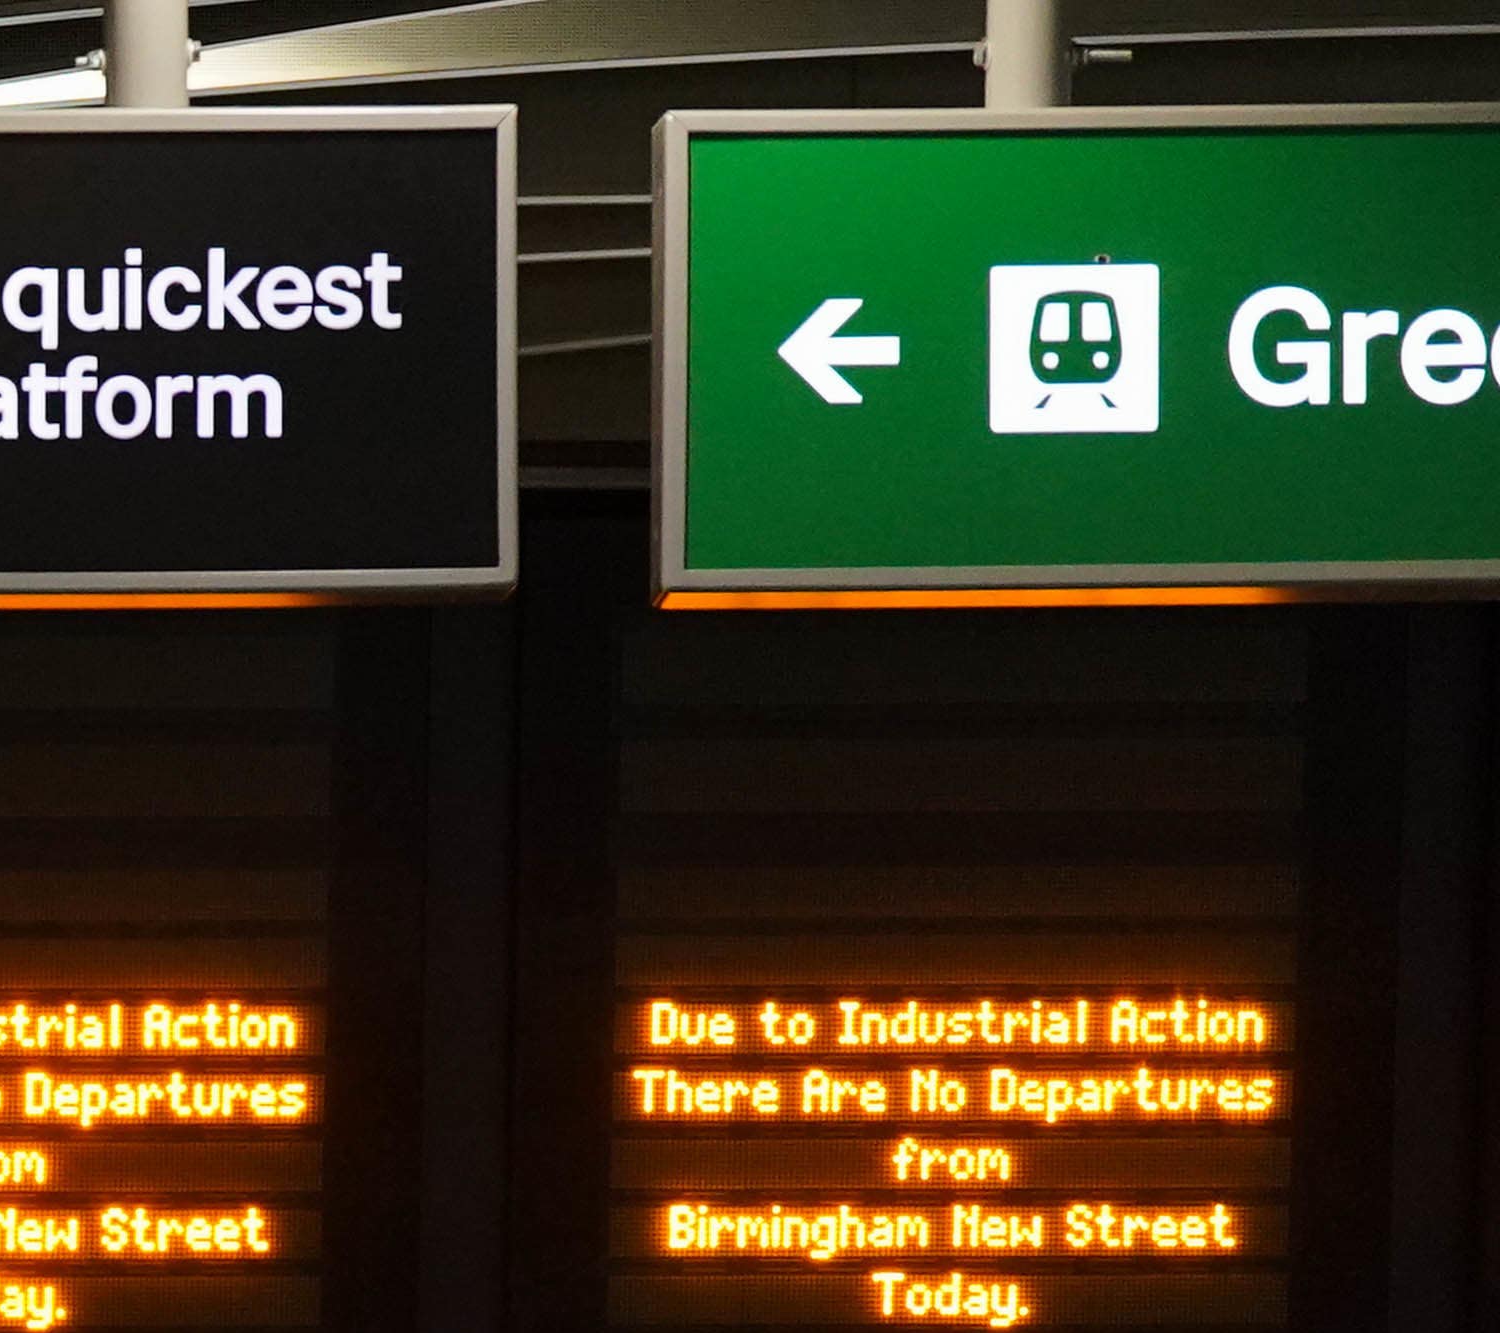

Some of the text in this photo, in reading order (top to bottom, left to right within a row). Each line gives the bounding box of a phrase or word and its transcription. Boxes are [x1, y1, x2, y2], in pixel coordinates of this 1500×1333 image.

[3, 248, 402, 349] quickest
[1228, 285, 1500, 407] Gre
[139, 1003, 298, 1050] Action
[649, 998, 1267, 1047] Due to Industrial Action
[21, 1069, 307, 1128] Departures
[632, 1067, 1275, 1123] There Are No Departures
[891, 1137, 1012, 1181] from
[99, 1206, 270, 1253] Street
[665, 1203, 1237, 1261] Birmingham New Street
[871, 1271, 1030, 1328] Today.
